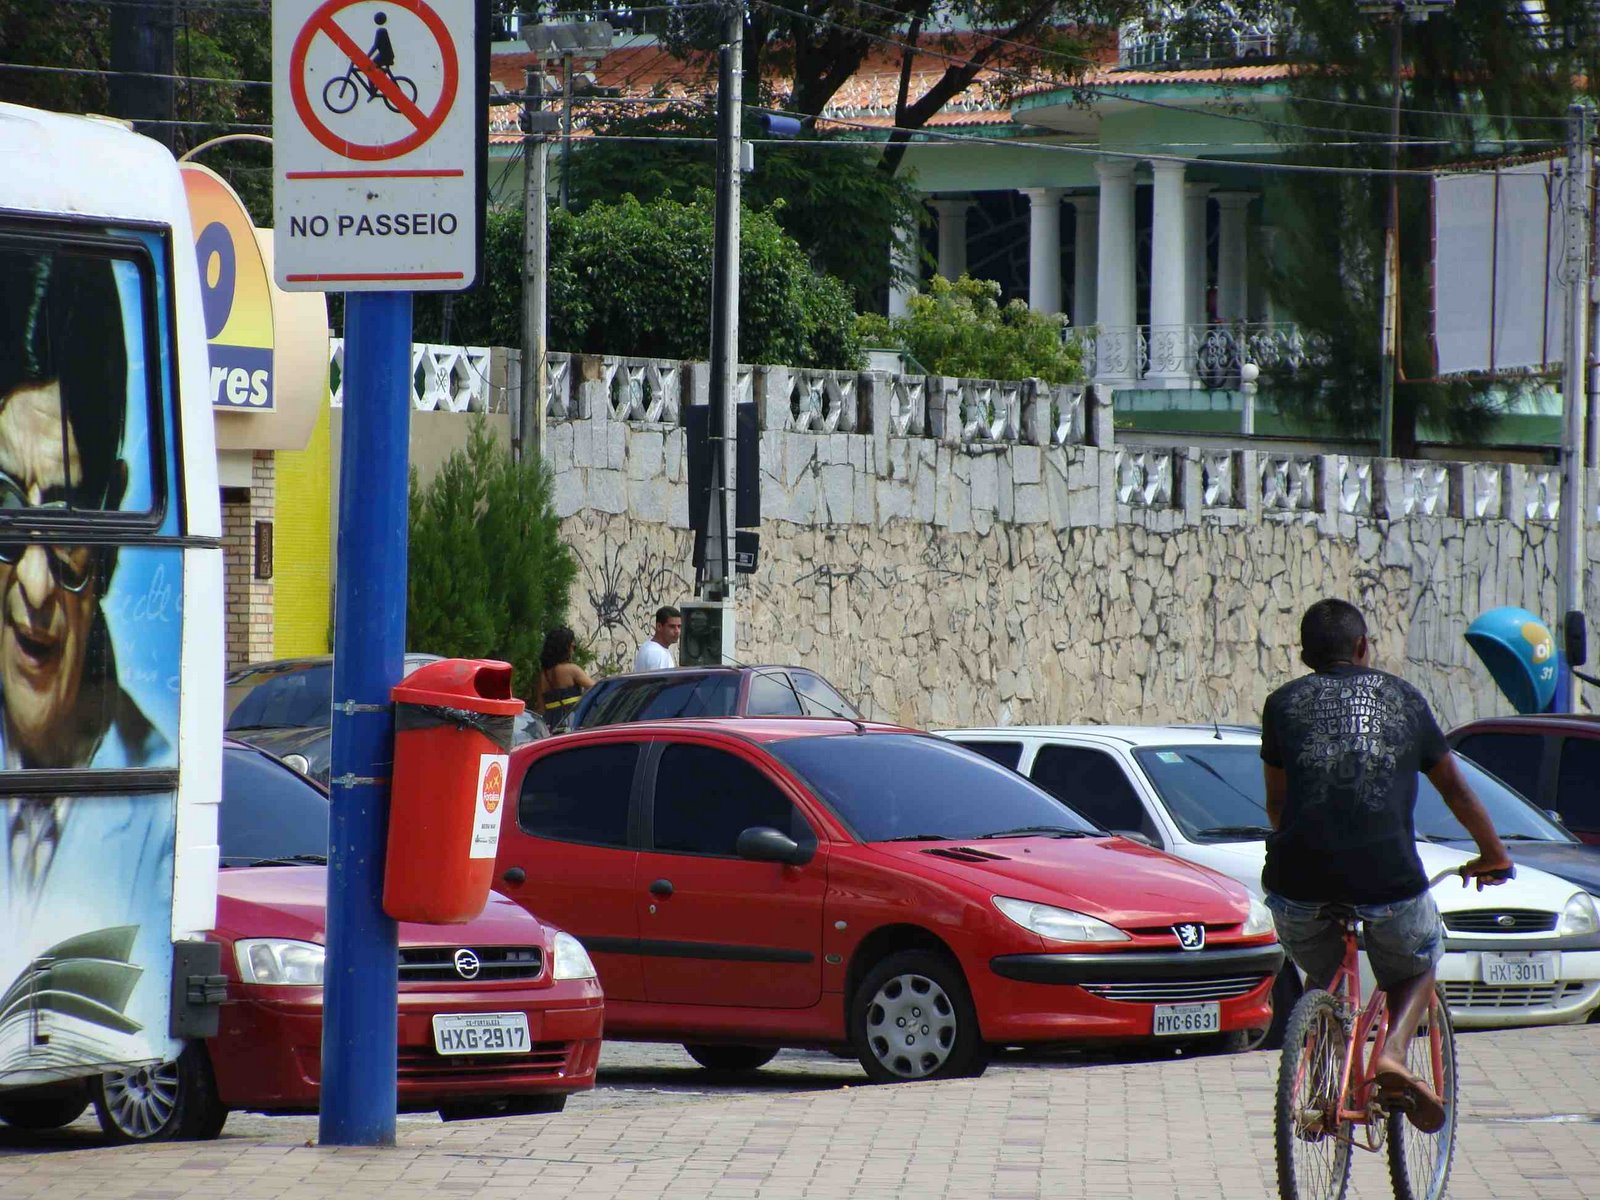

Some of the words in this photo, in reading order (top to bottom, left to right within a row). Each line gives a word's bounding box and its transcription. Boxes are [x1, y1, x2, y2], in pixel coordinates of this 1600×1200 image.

[290, 215, 329, 237] NO
[338, 212, 458, 237] PASSEIO
[1541, 666, 1554, 680] 31
[1316, 715, 1381, 735] SERIES
